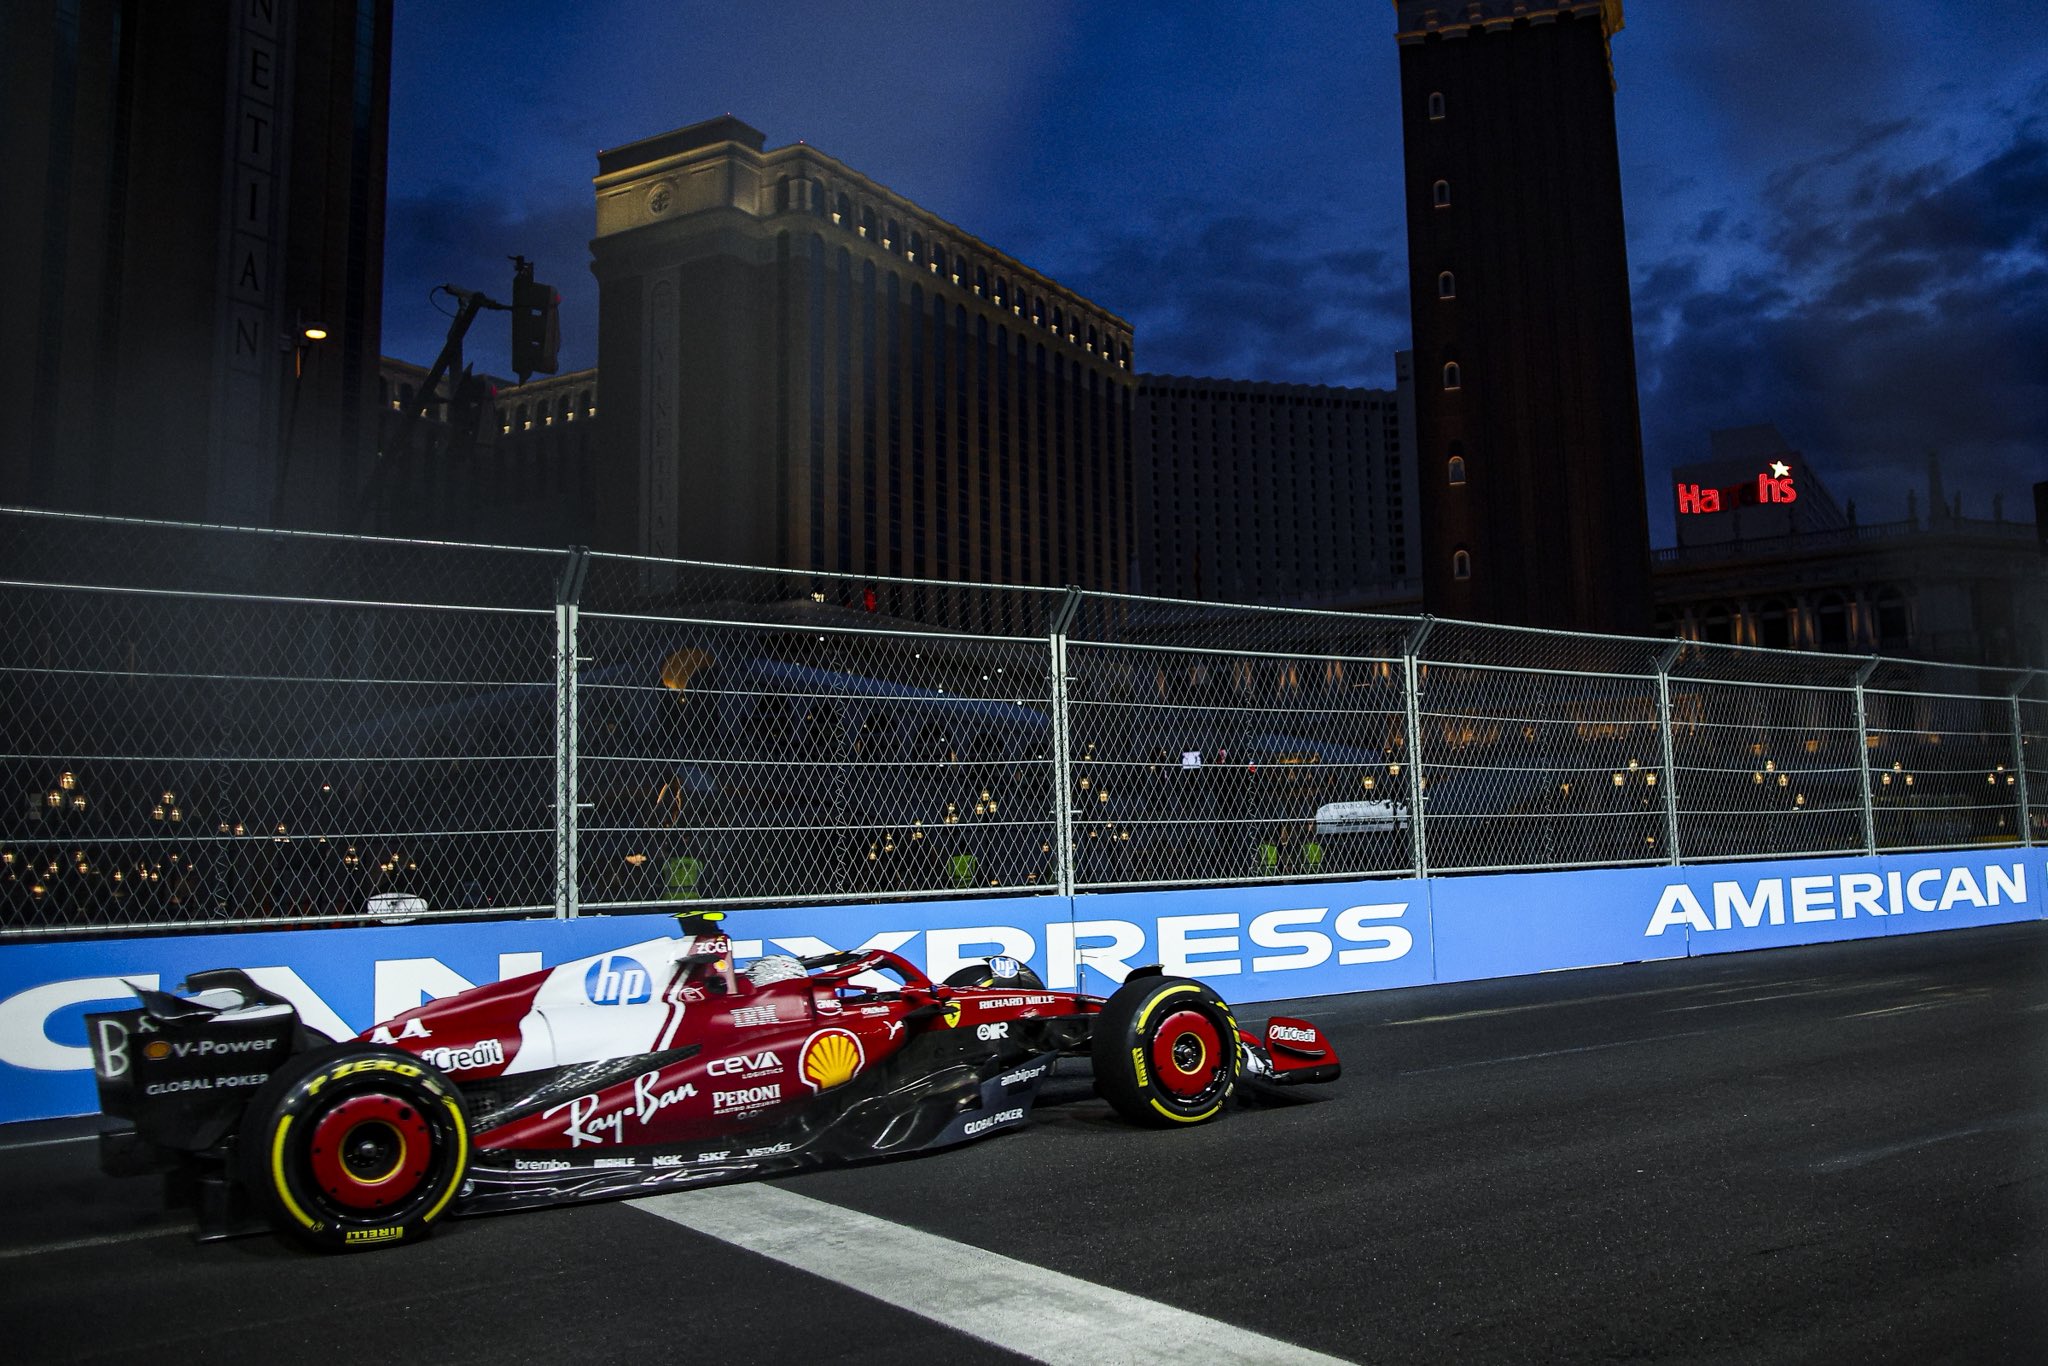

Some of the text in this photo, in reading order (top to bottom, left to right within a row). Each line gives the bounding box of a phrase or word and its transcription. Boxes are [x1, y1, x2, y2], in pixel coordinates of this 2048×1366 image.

[1644, 863, 2028, 936] AMERICAN
[593, 955, 646, 1005] hp
[816, 999, 842, 1011] aws
[979, 995, 1055, 1010] RICHARD MILLE
[172, 1038, 277, 1058] V-Power
[331, 1059, 422, 1081] ZERO
[1000, 1067, 1041, 1086] ambipar
[146, 1073, 269, 1096] GLOBAL POKER
[712, 1083, 782, 1109] PERONI
[963, 1108, 1024, 1135] GLOBAL POKER
[515, 1158, 571, 1170] brembo
[652, 1155, 683, 1166] NGK
